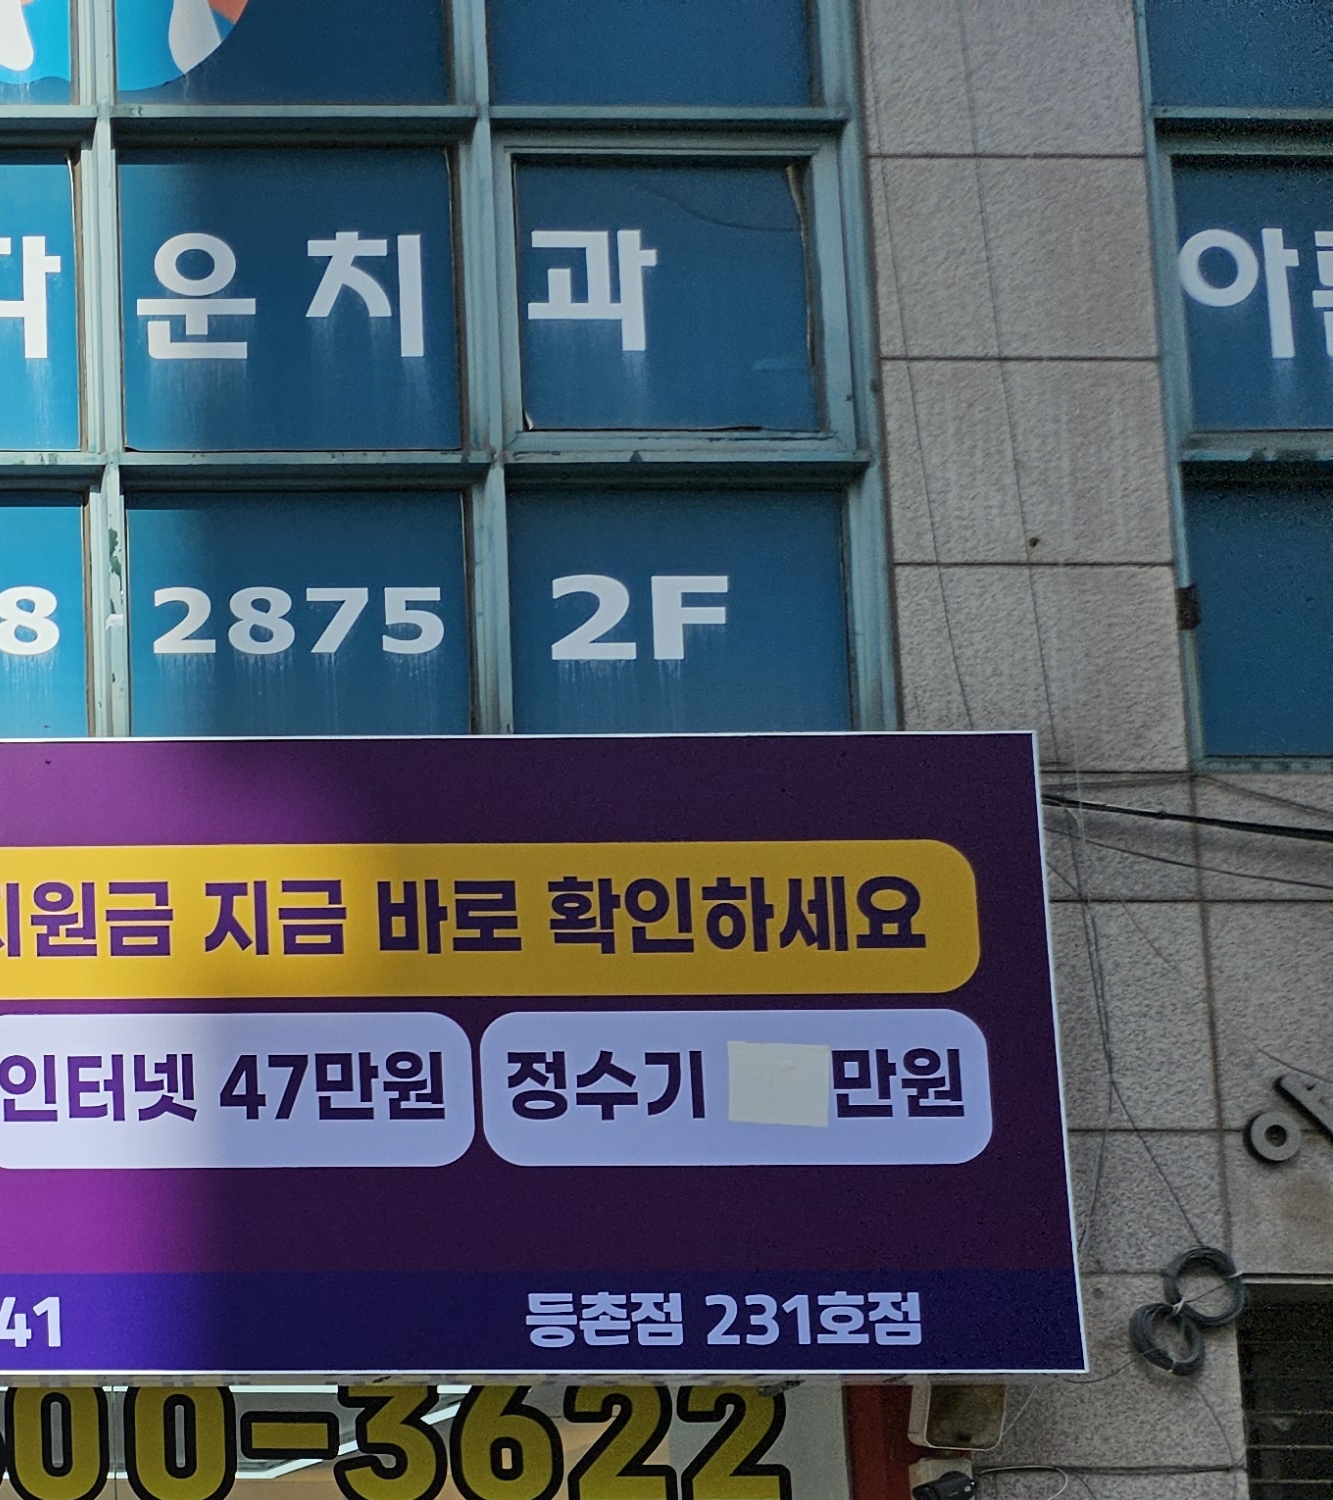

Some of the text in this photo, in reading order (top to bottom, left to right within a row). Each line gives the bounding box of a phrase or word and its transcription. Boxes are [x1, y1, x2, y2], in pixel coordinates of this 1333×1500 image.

[1178, 228, 1333, 359] 아
[551, 574, 729, 660] 2F
[205, 880, 347, 956] 지금
[377, 879, 523, 955] 바로
[547, 876, 927, 955] 확인하세요
[219, 1051, 446, 1122] 47만원
[506, 1050, 706, 1121] 정수기
[525, 1292, 922, 1348] 등촌점 231호점
